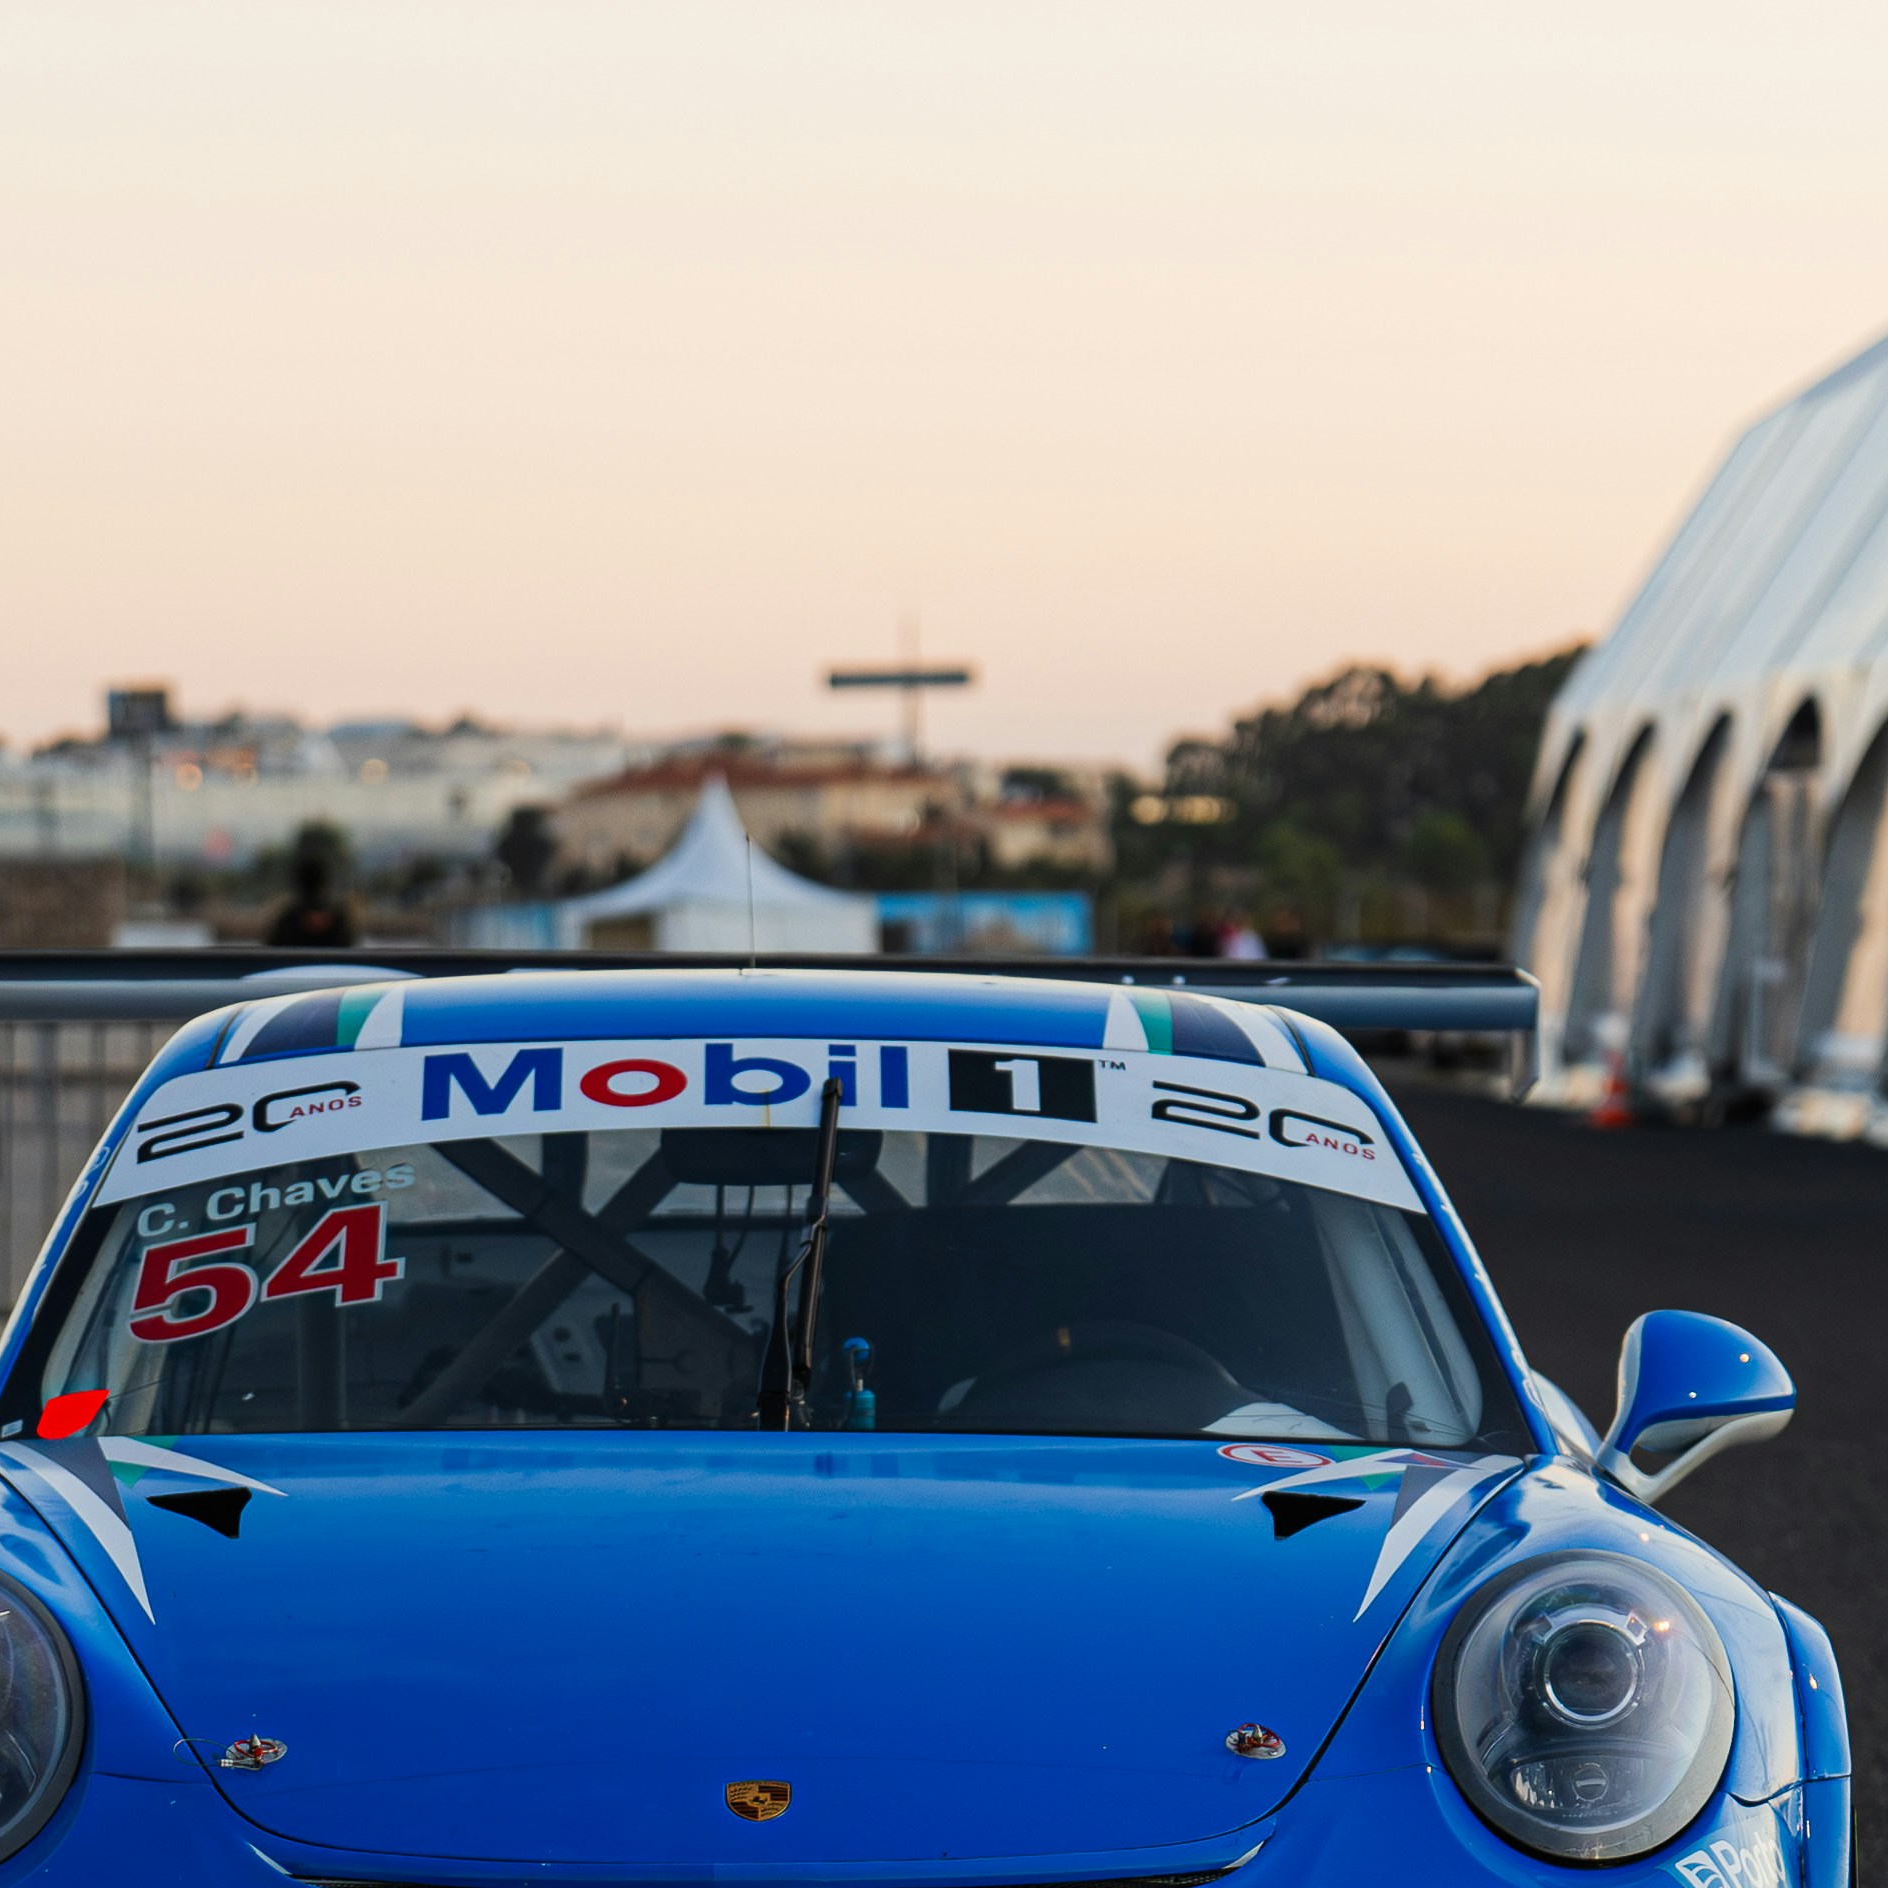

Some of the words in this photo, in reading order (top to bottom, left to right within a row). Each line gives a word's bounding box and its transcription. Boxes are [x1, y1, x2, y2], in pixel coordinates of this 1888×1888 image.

[289, 1095, 363, 1119] ANOS
[420, 1042, 910, 1121] Mobil
[1304, 1132, 1376, 1161] ANOS
[137, 1202, 189, 1238] C.
[205, 1162, 416, 1221] Chaves
[127, 1200, 406, 1343] 54
